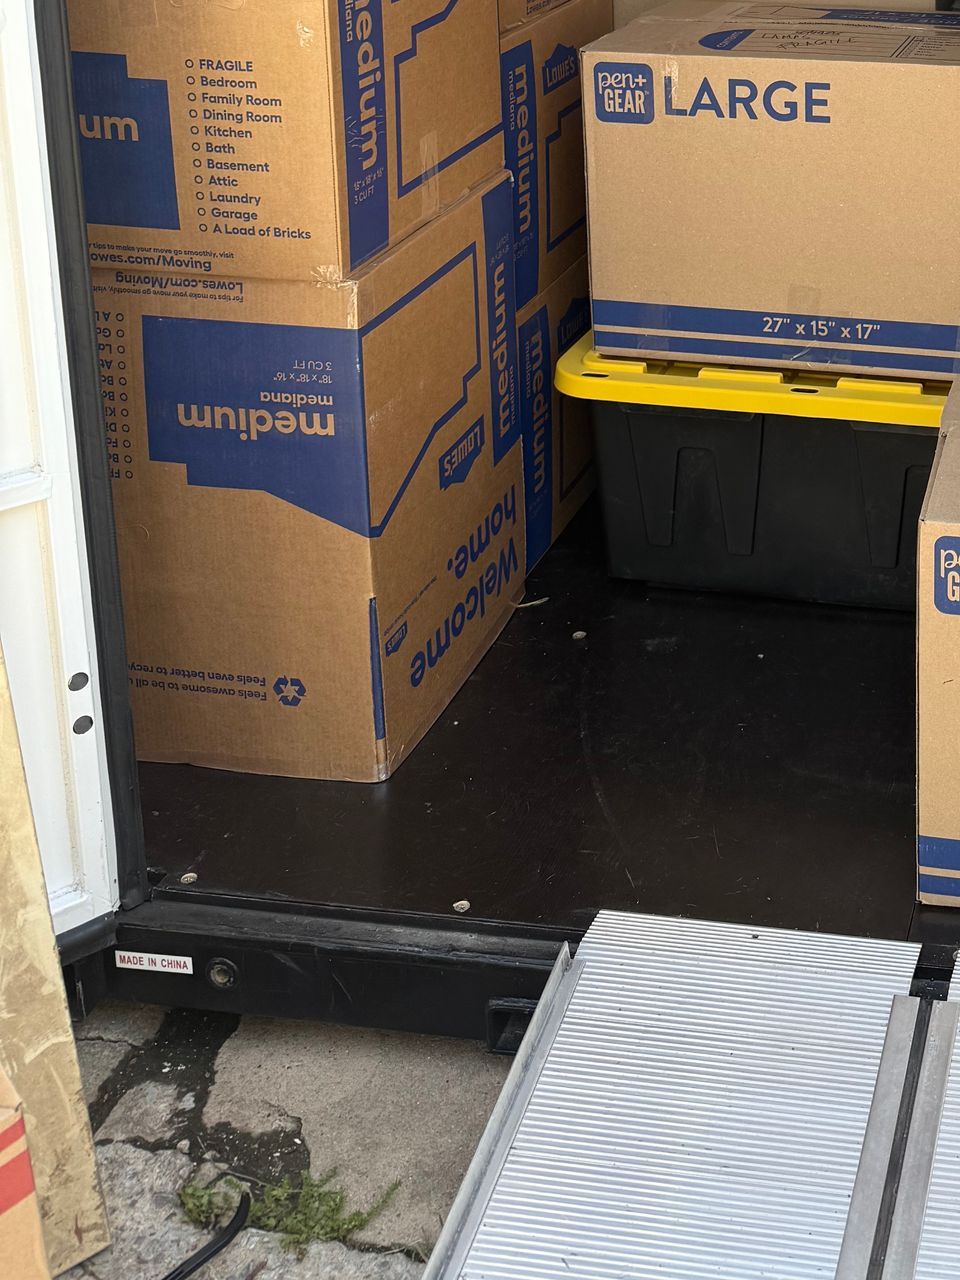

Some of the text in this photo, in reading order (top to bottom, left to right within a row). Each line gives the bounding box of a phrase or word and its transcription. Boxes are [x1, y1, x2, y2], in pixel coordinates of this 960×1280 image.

[200, 59, 253, 72] FRAGILE
[546, 57, 576, 87] LOWE'S
[201, 76, 257, 89] Bedroom
[202, 93, 282, 107] Family Room
[604, 88, 646, 114] GEAR
[665, 76, 831, 124] LARGE
[203, 110, 282, 123] Dining Room
[204, 126, 252, 138] Kitchen
[206, 143, 235, 154] Bath
[513, 64, 535, 232] medium
[207, 159, 269, 172] Basement
[209, 175, 238, 187] Attic
[210, 192, 261, 206] Laundry
[212, 208, 258, 222] Garage
[213, 224, 311, 239] A Load of Bricks
[90, 253, 212, 271] owes.com/Moving
[116, 271, 243, 294] Lowes.com/Moving
[763, 317, 881, 339] 27" x 15" x 17"
[492, 262, 510, 439] medium
[293, 360, 332, 370] 3 CU FT
[274, 372, 287, 382] 16"
[297, 373, 310, 383] 18"
[319, 374, 332, 384] 18"
[260, 392, 333, 407] mediana
[531, 332, 549, 493] medium
[177, 403, 335, 441] medium
[444, 426, 480, 477] LOWE'S
[447, 485, 516, 580] home.
[410, 538, 518, 688] Welcome
[156, 667, 168, 676] to
[170, 668, 205, 681] better
[208, 672, 234, 682] even
[237, 675, 266, 686] Feels
[136, 679, 267, 700] Feels awesome to be all
[119, 955, 188, 970] MADE IN CHINA
